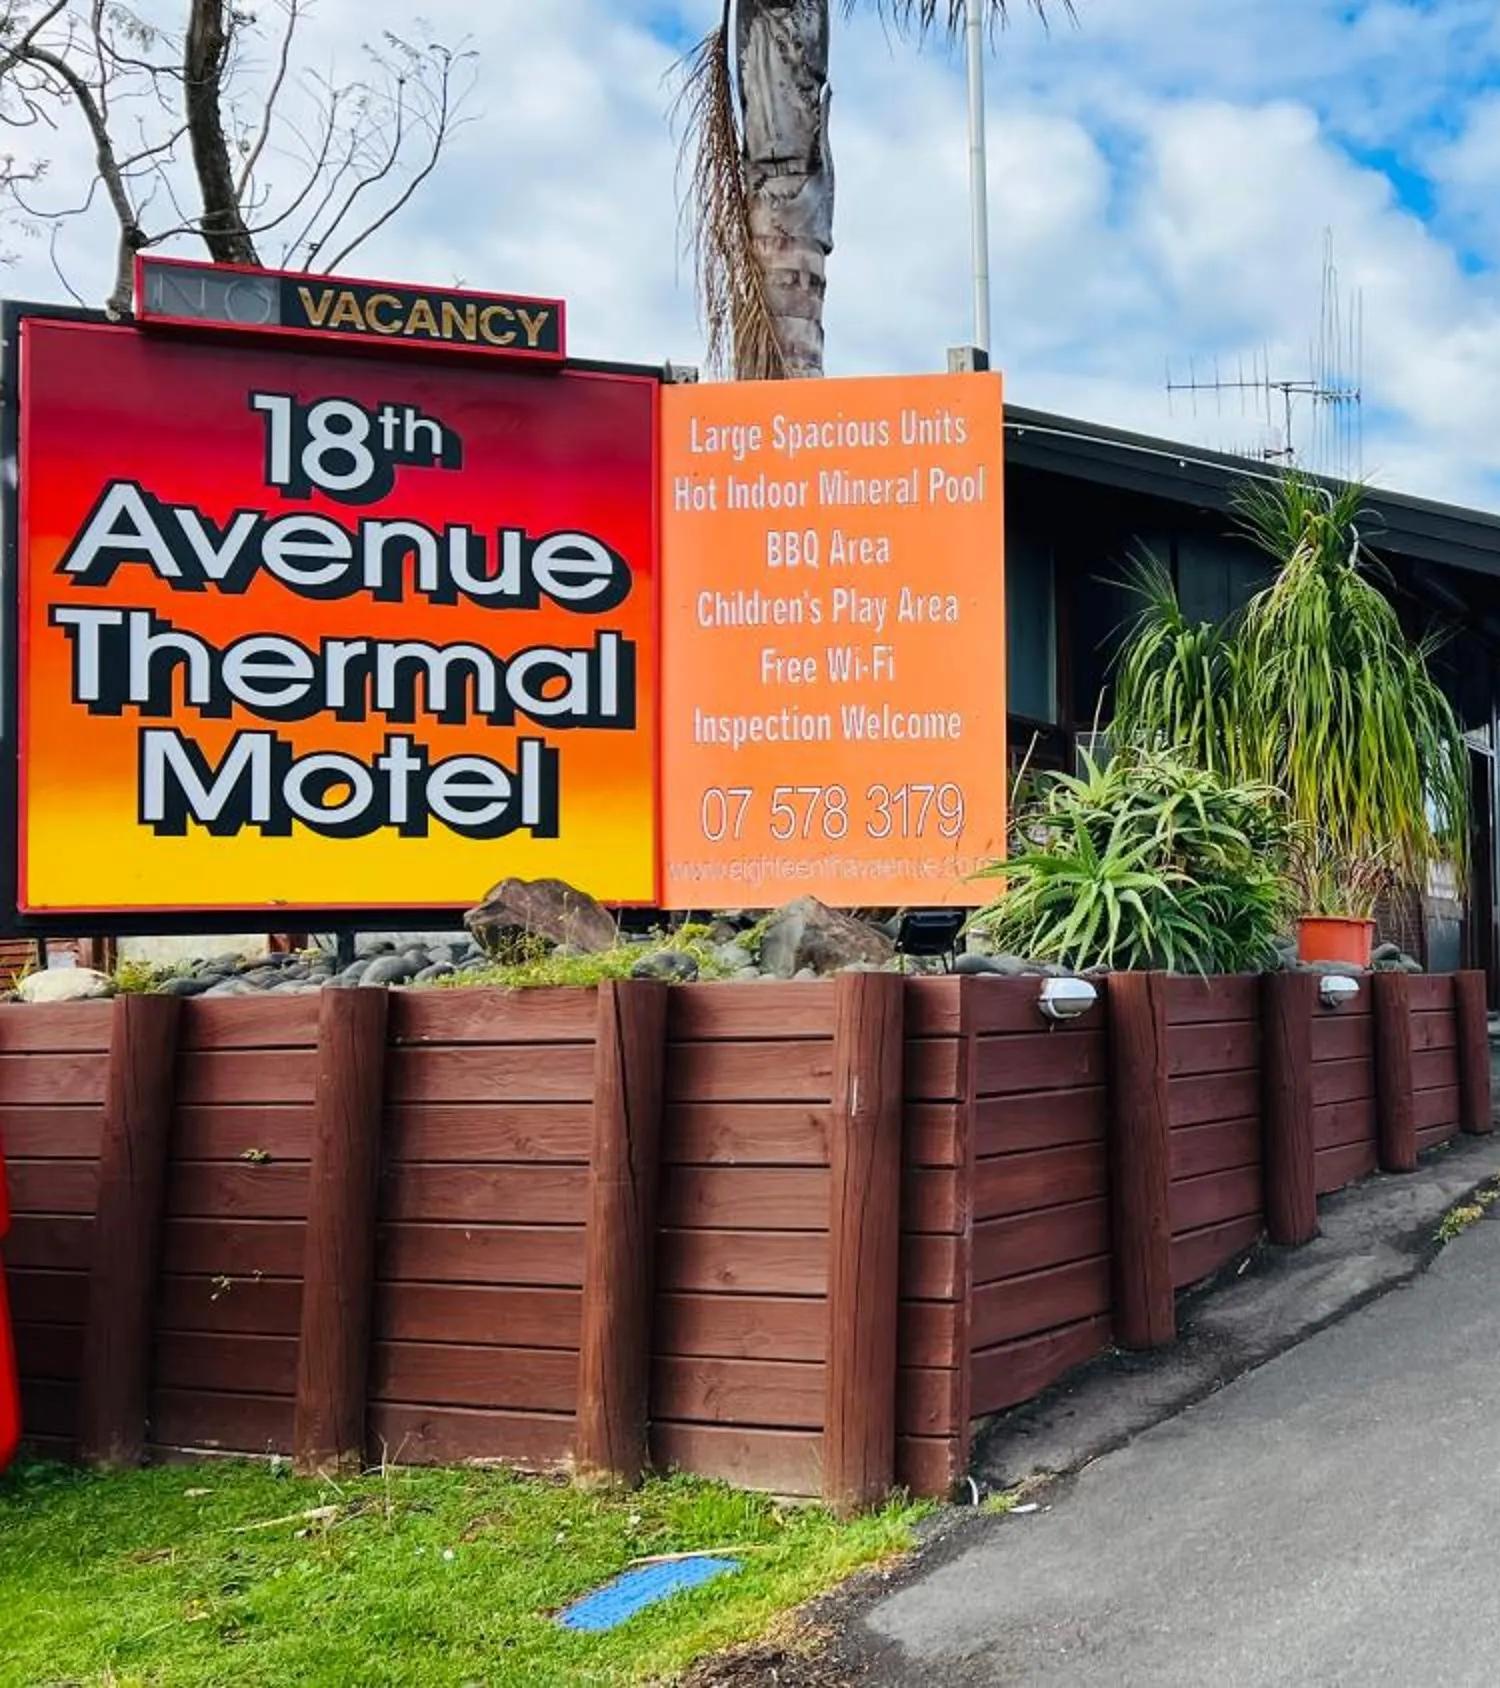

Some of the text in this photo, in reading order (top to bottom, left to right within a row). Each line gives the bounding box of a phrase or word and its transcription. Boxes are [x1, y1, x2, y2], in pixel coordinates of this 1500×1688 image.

[151, 271, 549, 347] NO VACANCY
[250, 392, 452, 498] 18th
[690, 408, 968, 462] Large Spacious Units
[673, 465, 987, 512] Hot Indoor Mineral Pool
[58, 481, 624, 607] Avenue
[766, 529, 890, 569] BBQ Area
[697, 586, 960, 633] Children's Play Area
[52, 606, 628, 722] Thermal
[761, 645, 895, 685] Free Wi-Fi
[694, 703, 962, 751] Inspection Welcome
[141, 728, 550, 833] Motel
[701, 782, 965, 842] 07 578 3179
